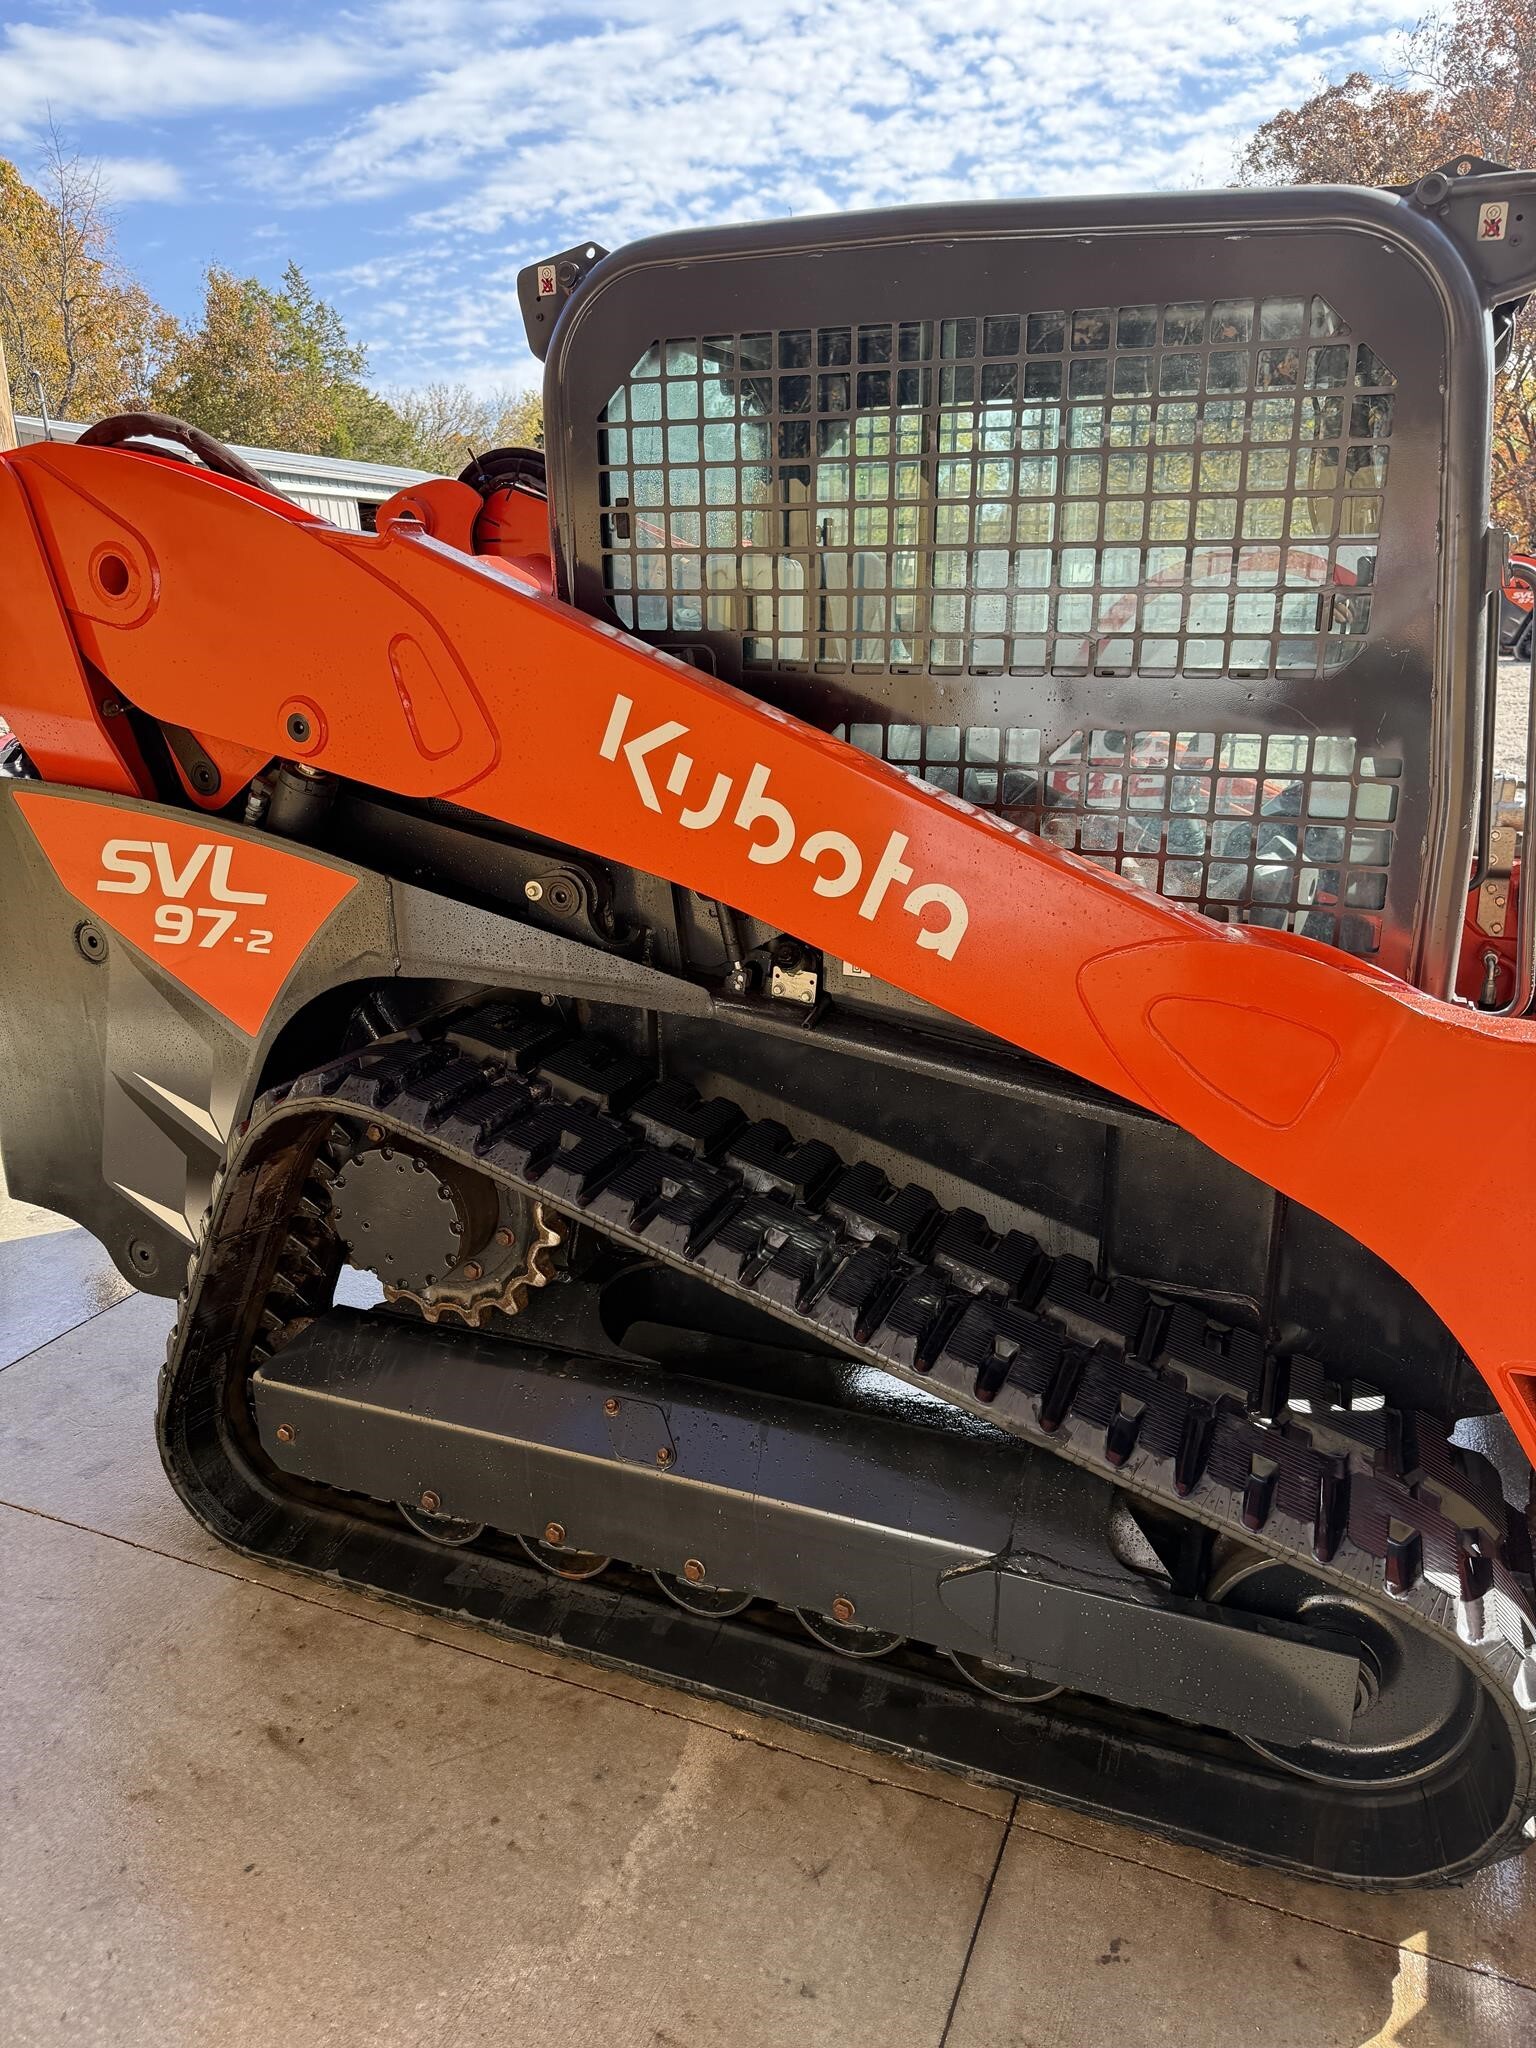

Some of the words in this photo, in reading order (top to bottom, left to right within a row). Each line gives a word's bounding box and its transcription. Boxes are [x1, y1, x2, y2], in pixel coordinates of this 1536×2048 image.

[599, 693, 969, 962] Kubota
[96, 839, 268, 905] SVL
[153, 904, 274, 954] 97-2
